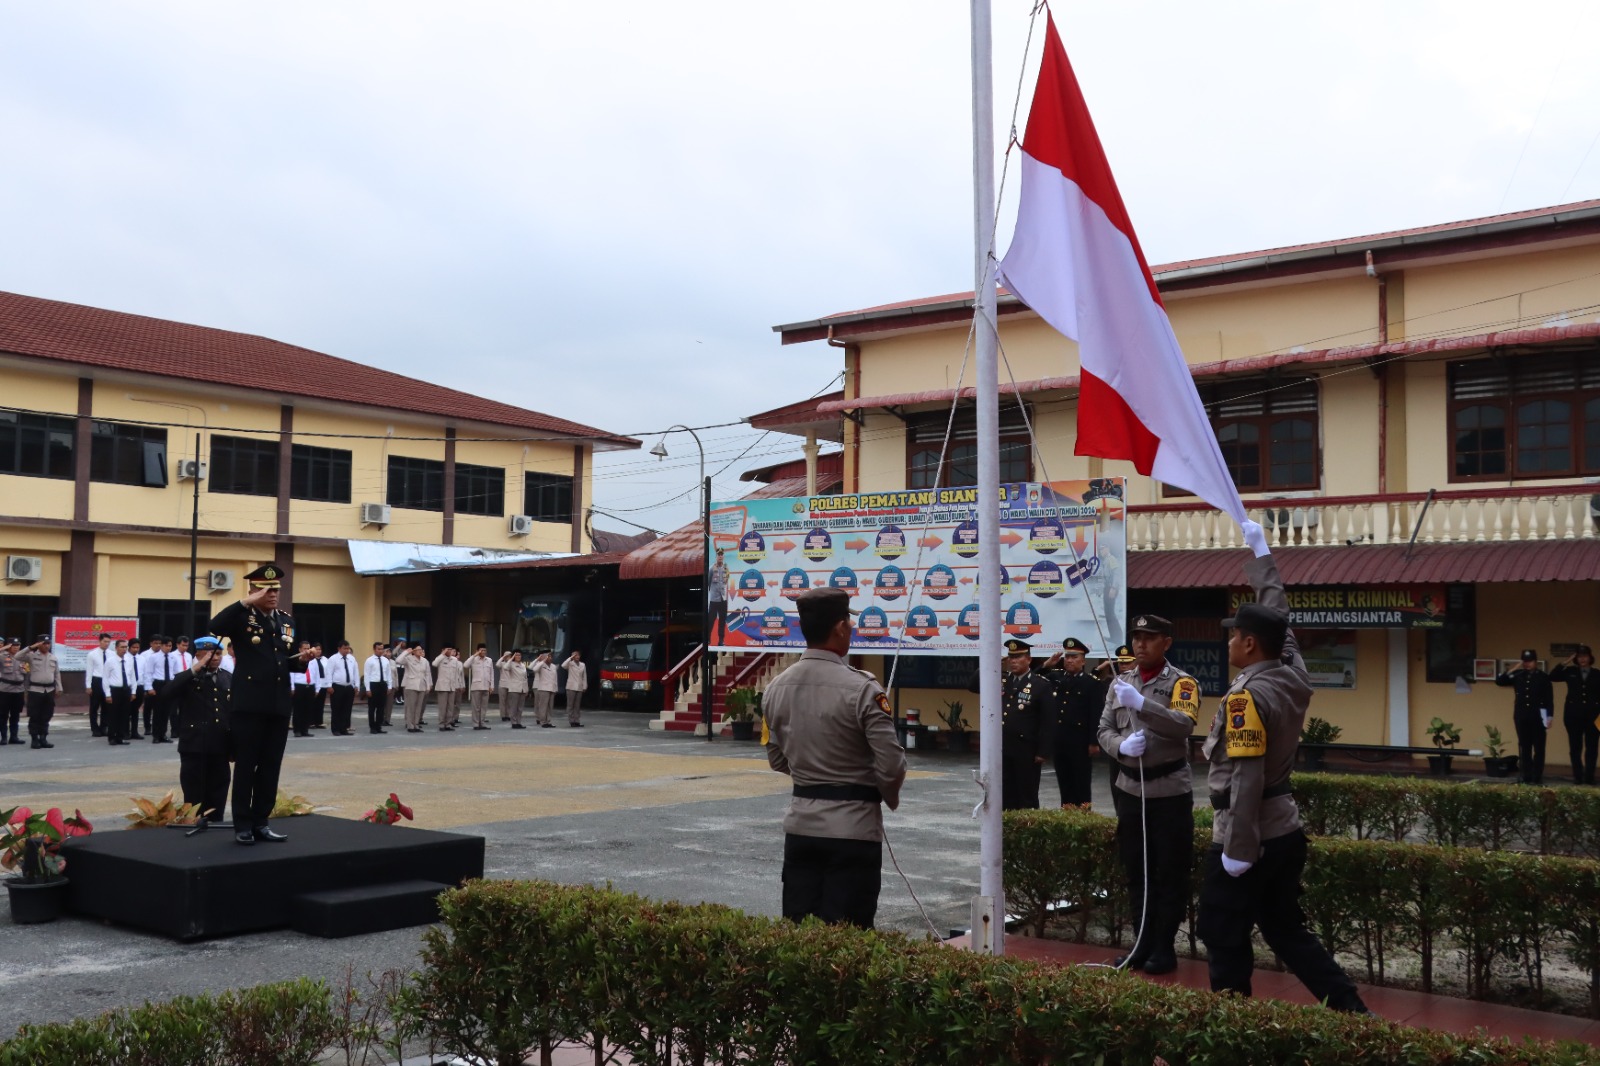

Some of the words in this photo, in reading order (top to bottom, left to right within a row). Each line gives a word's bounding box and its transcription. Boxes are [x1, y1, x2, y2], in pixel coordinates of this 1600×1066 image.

[809, 497, 858, 511] POLRES
[860, 490, 937, 509] PEMATANG
[940, 487, 1007, 504] SIANR
[1010, 509, 1027, 518] WAKIL
[1028, 507, 1058, 517] WALIKOTA
[1059, 506, 1079, 516] TAHUN
[829, 518, 854, 528] GUBERNUR
[862, 517, 877, 526] WAKIL
[1287, 591, 1344, 608] RESERSE
[1347, 590, 1414, 607] KRIMINAL
[1288, 611, 1402, 624] PEMATANGSIANTAR
[1175, 648, 1220, 663] TURN
[936, 675, 969, 686] CRIM
